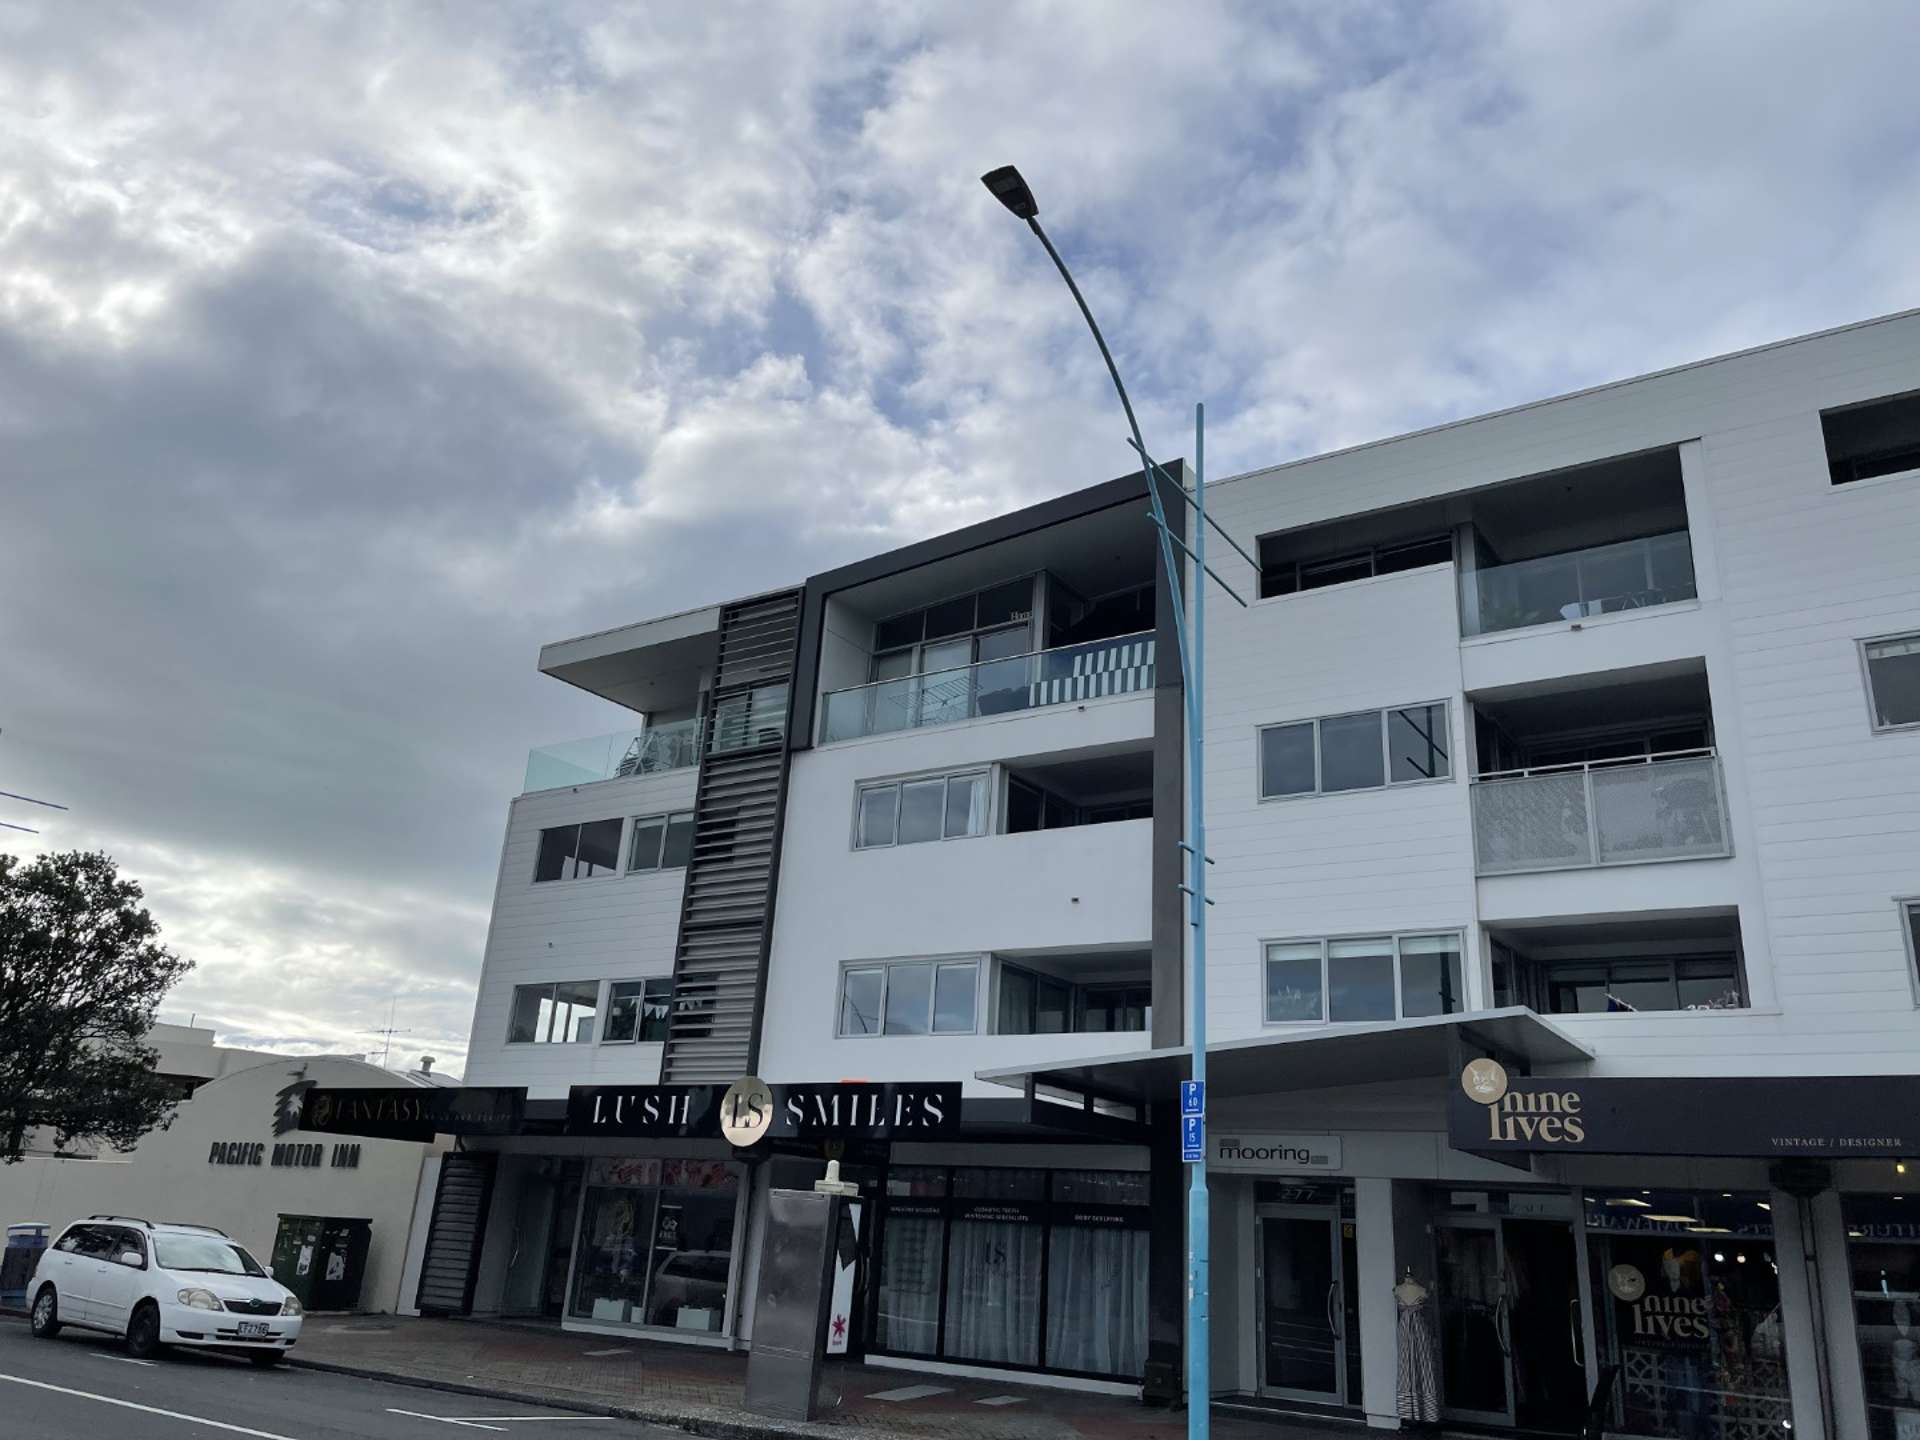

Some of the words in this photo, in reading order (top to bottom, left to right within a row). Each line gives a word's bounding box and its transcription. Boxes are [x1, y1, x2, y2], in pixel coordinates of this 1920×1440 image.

[1188, 1083, 1196, 1096] P
[593, 1094, 691, 1125] LUSH
[785, 1093, 946, 1127] SMILES
[730, 1092, 764, 1129] LS
[1503, 1089, 1581, 1113] nine
[1188, 1118, 1196, 1132] P
[1488, 1103, 1585, 1144] lives
[1188, 1131, 1196, 1143] 15
[1771, 1137, 1826, 1147] VINTAGE
[1839, 1137, 1903, 1147] DESIGNER
[208, 1141, 266, 1166] PACIFIC
[271, 1143, 323, 1168] MOTOR
[331, 1143, 361, 1168] INN
[1219, 1145, 1310, 1164] mooring
[1644, 1294, 1708, 1315] nine
[1633, 1303, 1710, 1339] lives
